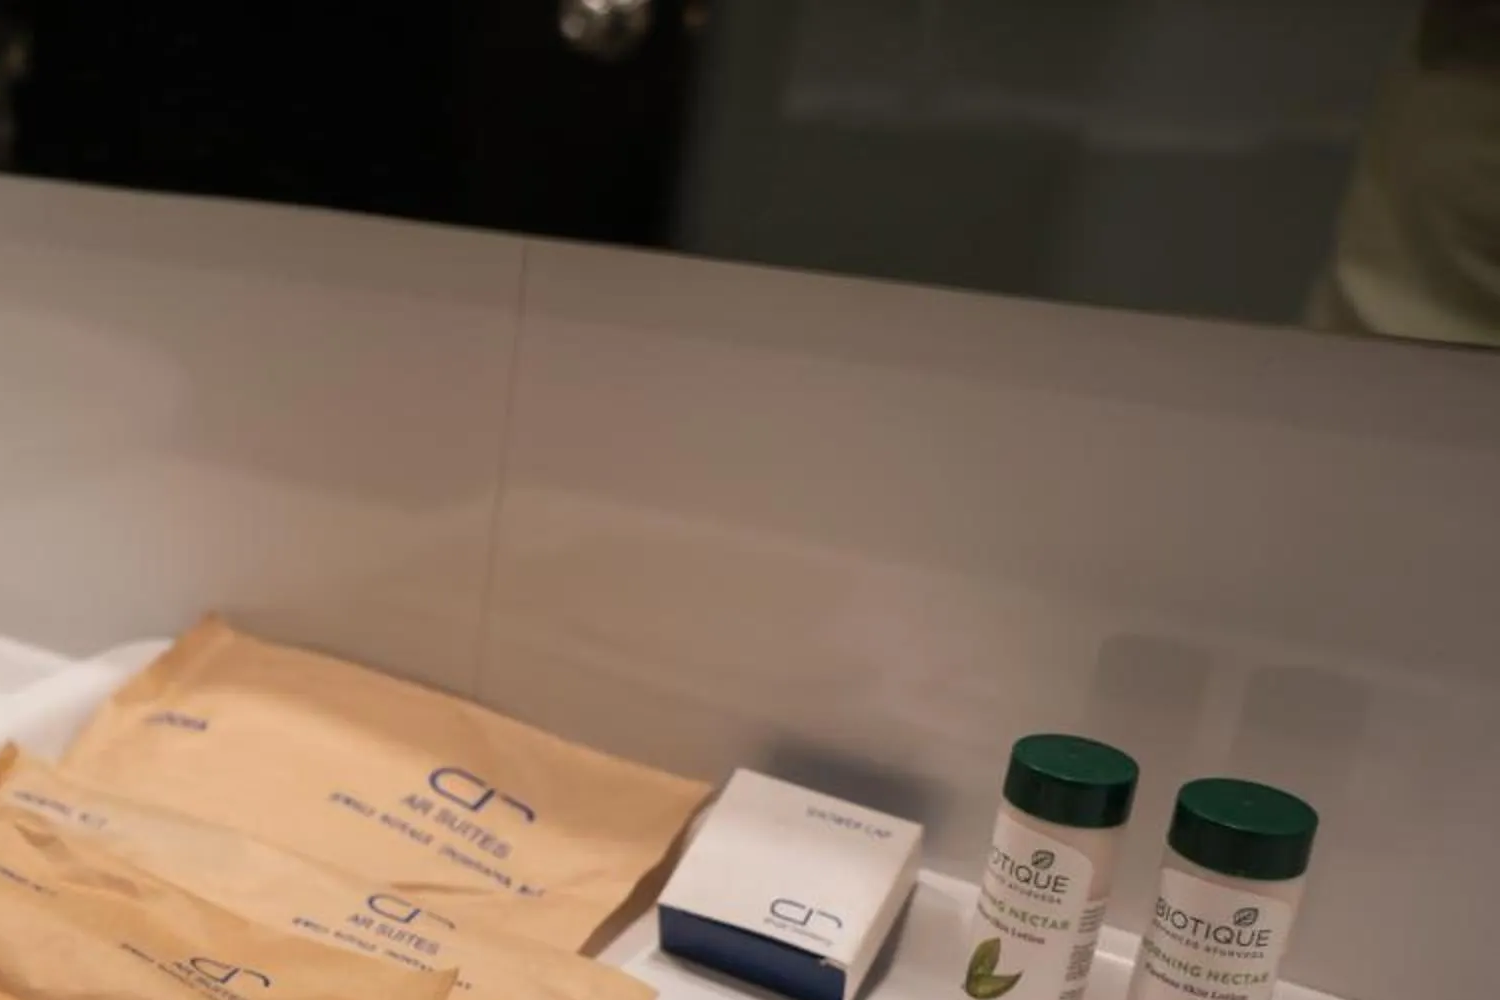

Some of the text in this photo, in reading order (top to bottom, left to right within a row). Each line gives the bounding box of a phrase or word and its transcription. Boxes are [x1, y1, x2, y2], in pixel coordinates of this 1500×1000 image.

[402, 794, 433, 816] AR
[434, 808, 511, 859] SUITES
[348, 914, 375, 929] AR
[376, 923, 440, 955] SUITES
[1155, 896, 1273, 947] BIOTIQUE
